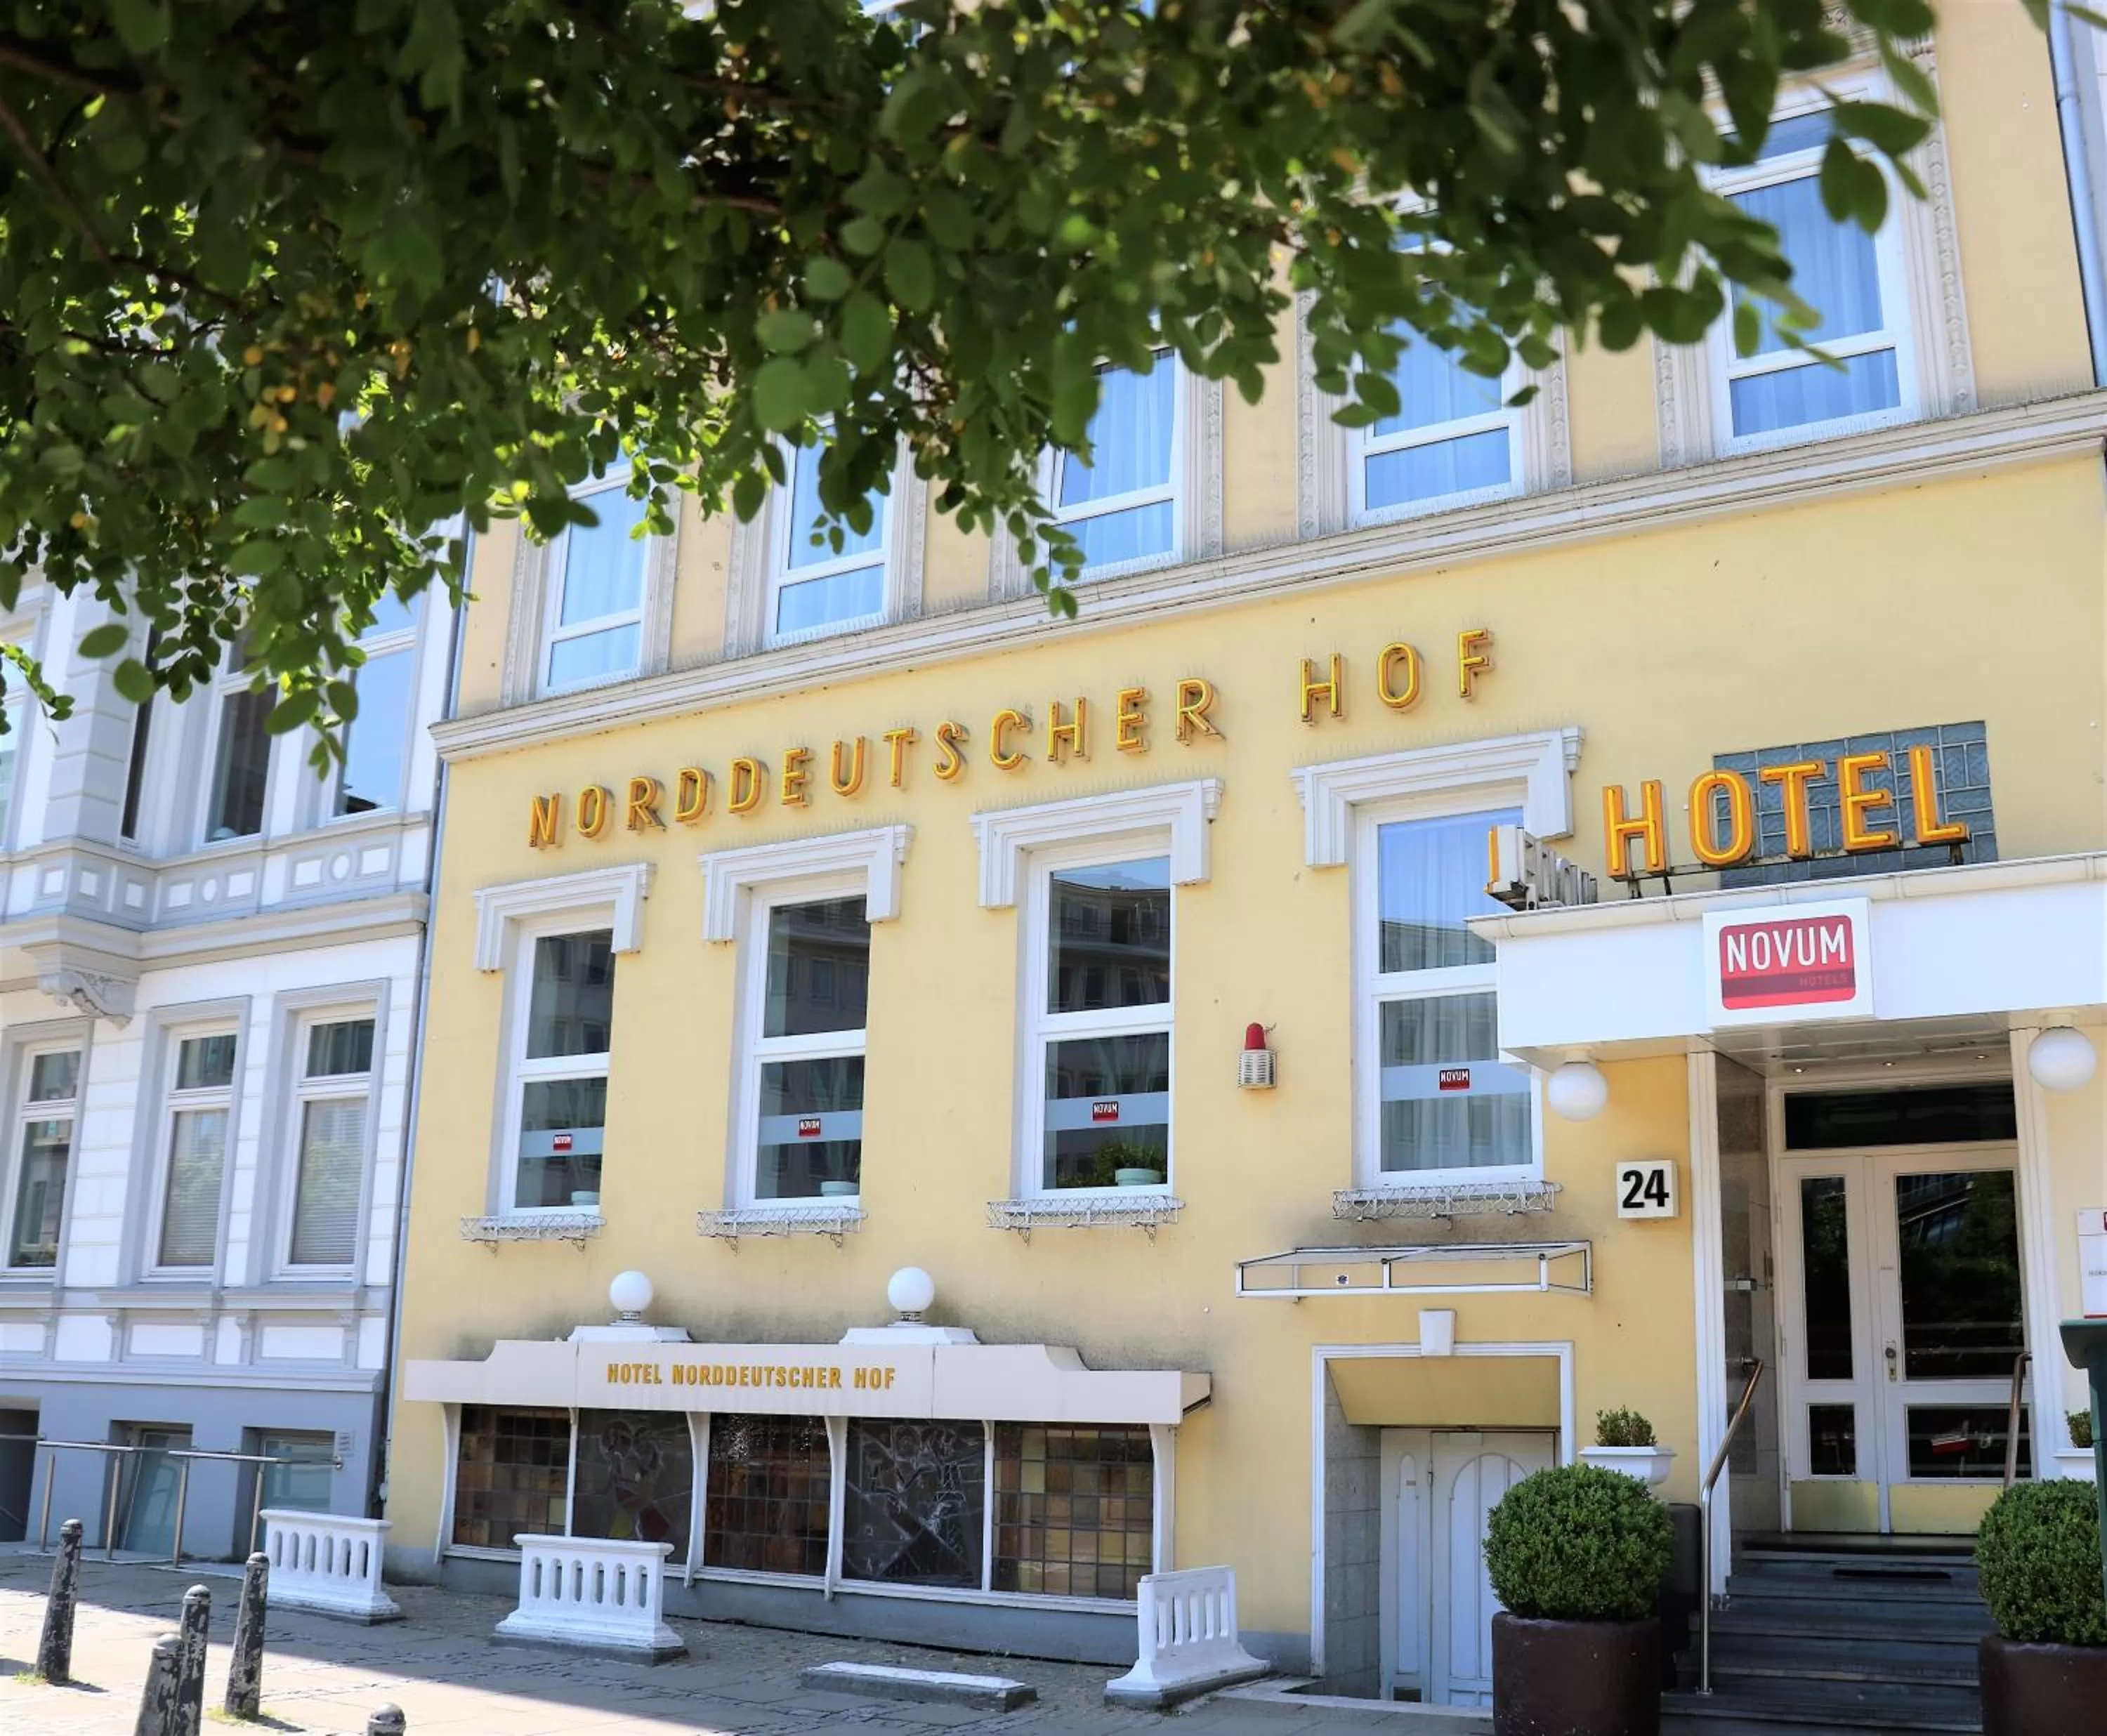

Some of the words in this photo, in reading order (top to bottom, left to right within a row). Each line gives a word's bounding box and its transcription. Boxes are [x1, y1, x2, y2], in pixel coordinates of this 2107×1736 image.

[529, 677, 1225, 848] NORDDEUTSCHER
[1301, 630, 1490, 721] HOF
[1602, 744, 1969, 879] HOTEL
[1727, 923, 1846, 973] NOVUM
[1799, 972, 1849, 987] HOTELS
[1440, 1070, 1469, 1082] NOVUM
[1622, 1169, 1669, 1208] 24
[607, 1363, 662, 1384] HOTEL
[672, 1365, 842, 1388] NORDDEUTSCHER
[853, 1367, 896, 1389] HOF
